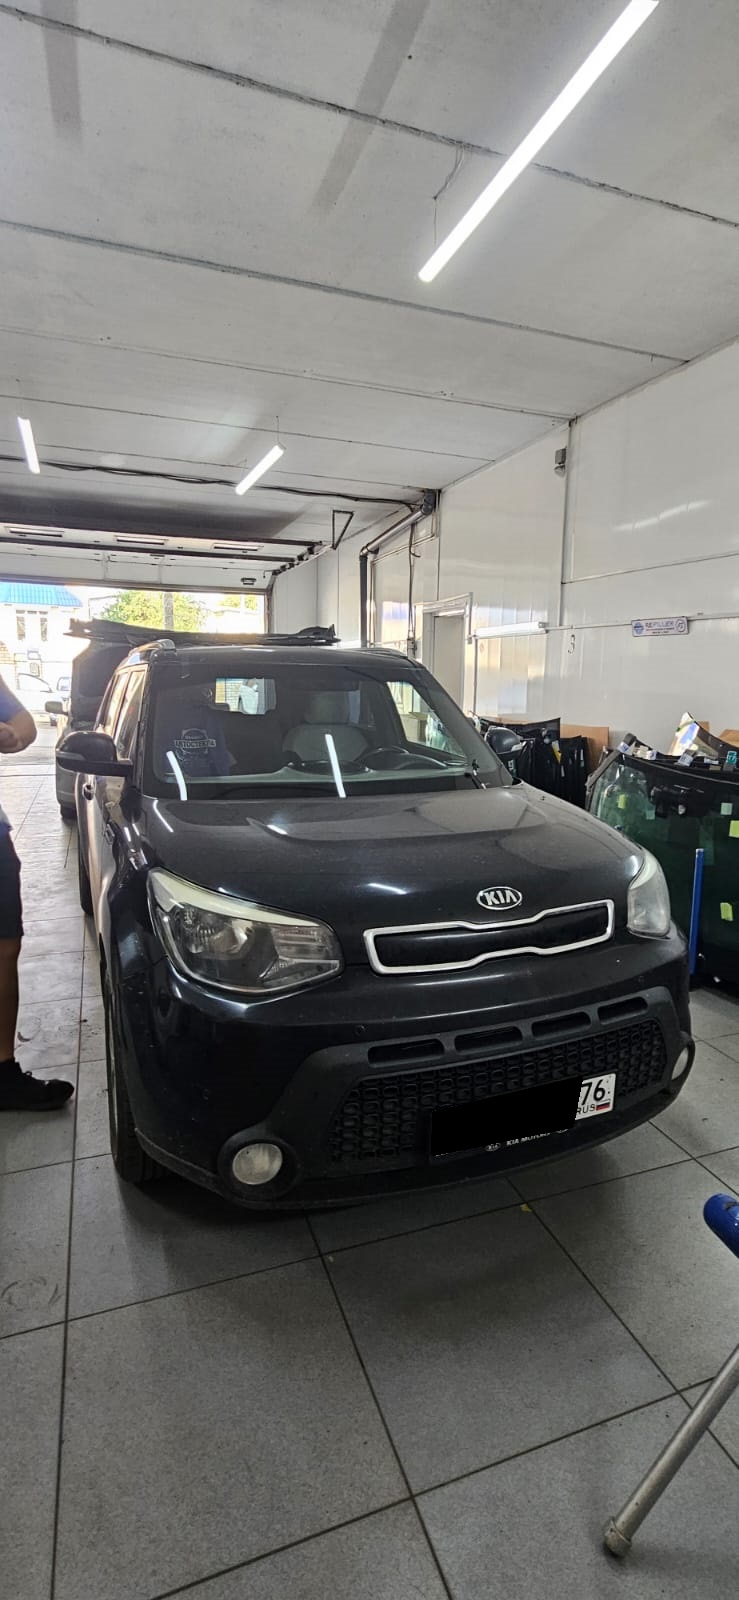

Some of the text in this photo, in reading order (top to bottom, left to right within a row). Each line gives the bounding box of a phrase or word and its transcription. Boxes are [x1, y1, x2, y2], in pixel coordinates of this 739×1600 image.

[483, 889, 518, 906] KIA
[580, 1079, 605, 1106] 76
[576, 1104, 595, 1115] RUS
